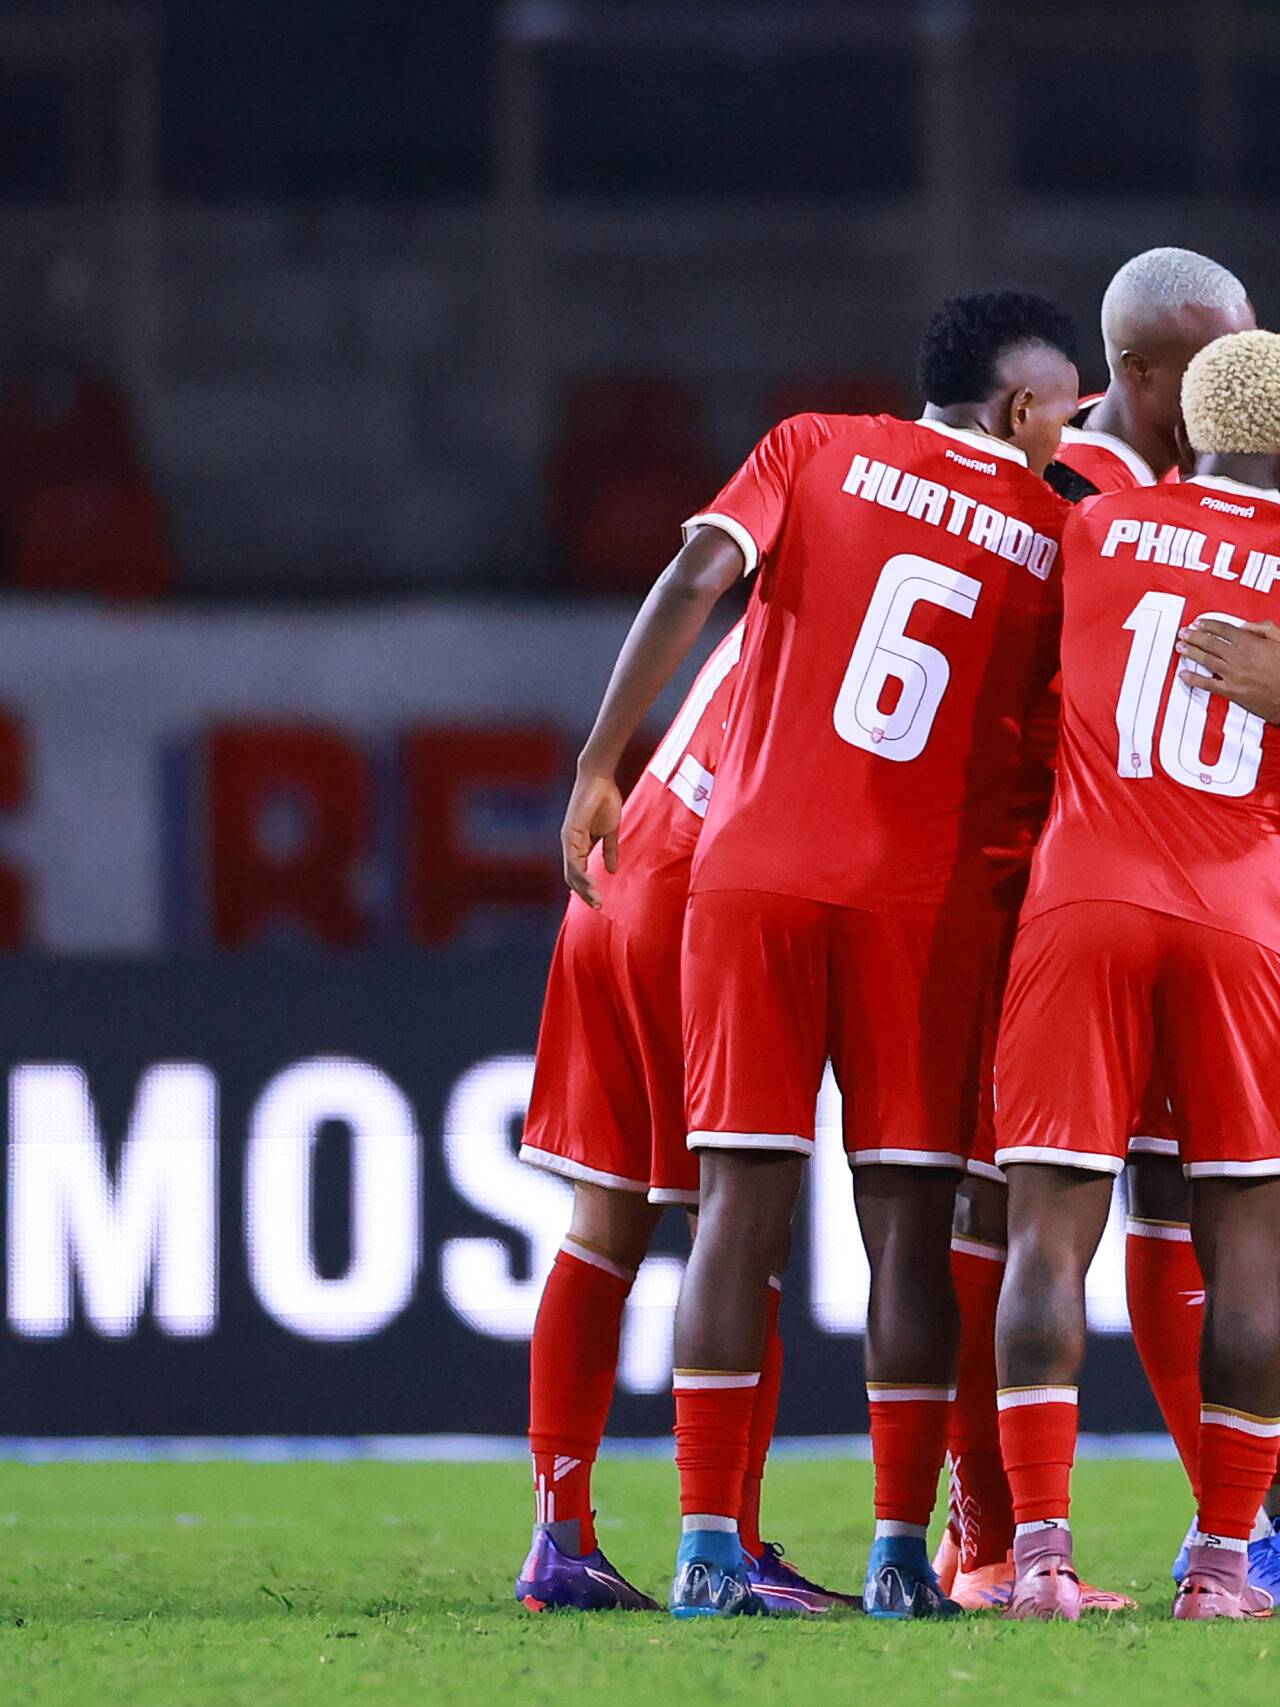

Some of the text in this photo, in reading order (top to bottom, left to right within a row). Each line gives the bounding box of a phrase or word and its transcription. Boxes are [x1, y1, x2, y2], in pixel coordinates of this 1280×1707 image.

[945, 449, 998, 476] PANAMÁ
[842, 454, 1058, 581] HURTADO
[1200, 496, 1256, 518] PANAMÁ
[832, 553, 983, 762] 6
